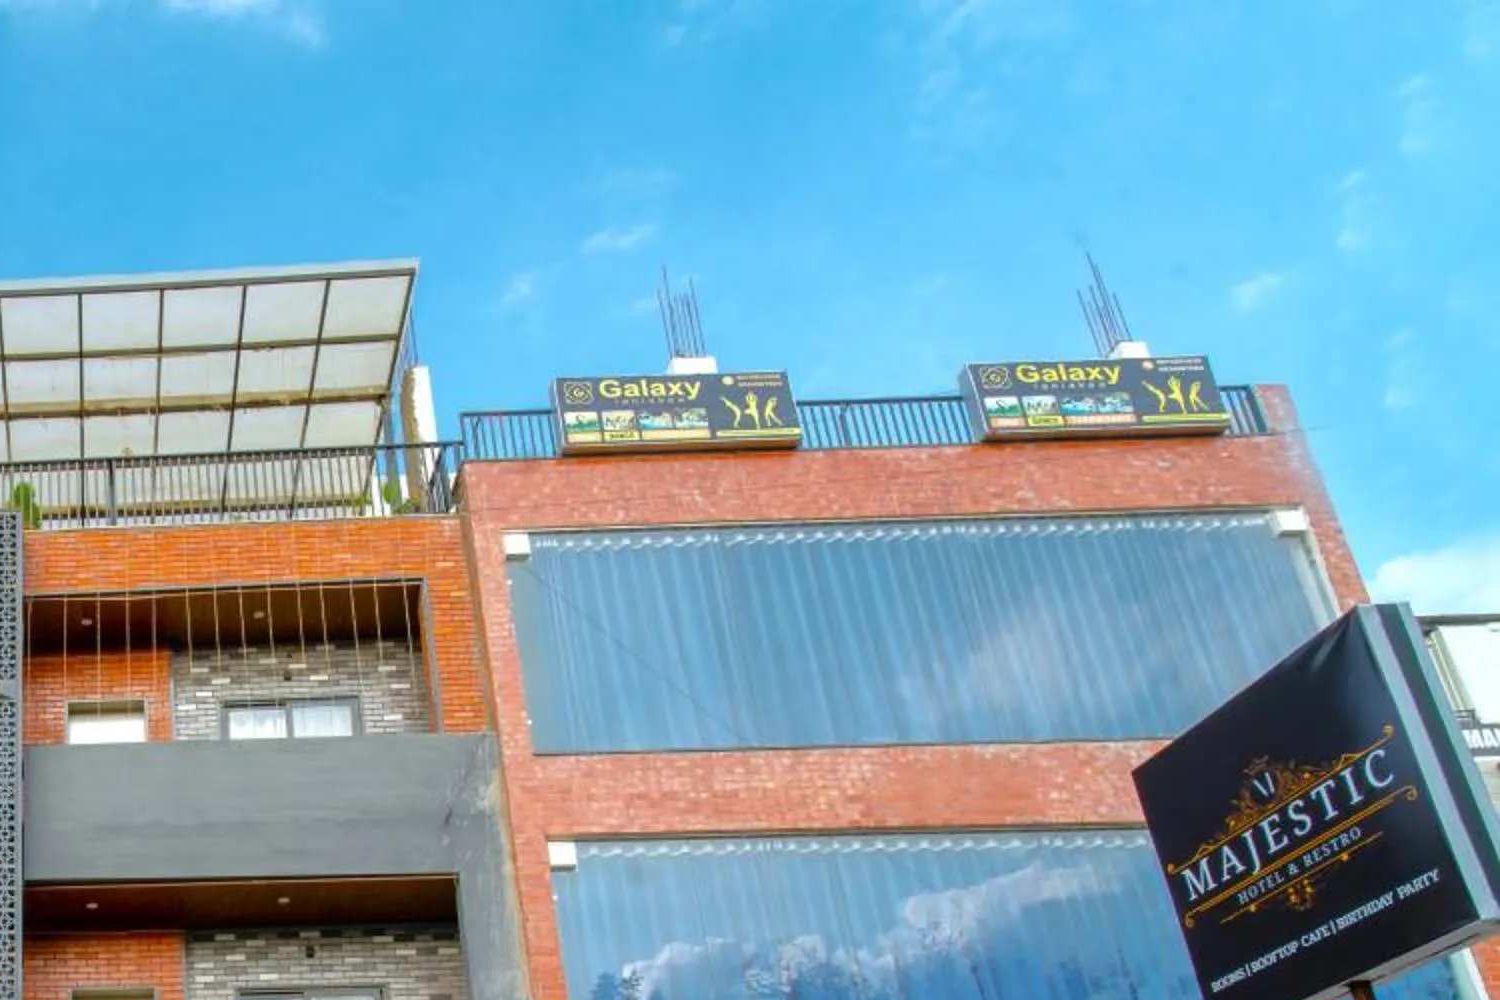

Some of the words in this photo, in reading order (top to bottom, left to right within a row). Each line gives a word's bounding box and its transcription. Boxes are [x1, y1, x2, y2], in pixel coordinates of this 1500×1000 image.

[600, 379, 700, 400] Galaxy
[1017, 364, 1121, 385] Galaxy
[1180, 749, 1394, 901] MAJESTIC
[1237, 870, 1284, 905] HOTEL
[1288, 863, 1300, 874] &
[1302, 827, 1361, 867] RESTRO
[1301, 924, 1330, 947] CAFE
[1337, 892, 1393, 930] BIRTHDAY
[1397, 869, 1440, 900] PARTY
